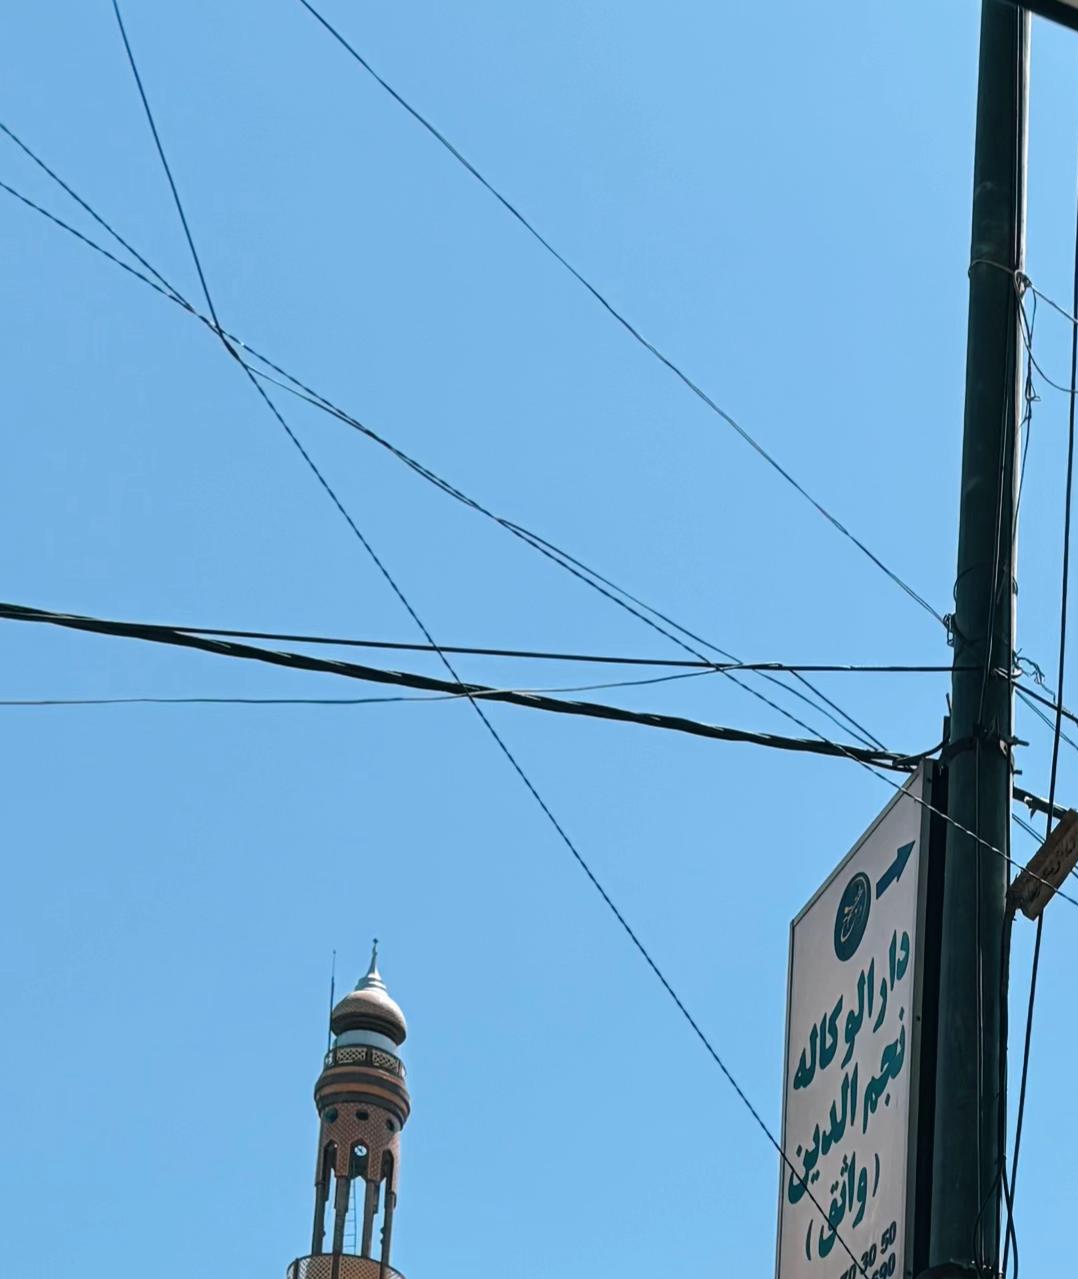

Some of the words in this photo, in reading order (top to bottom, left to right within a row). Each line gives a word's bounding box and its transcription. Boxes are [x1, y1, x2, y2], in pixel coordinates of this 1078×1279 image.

[862, 1006, 906, 1134] نجم
[860, 1243, 877, 1275] 30
[880, 1221, 897, 1254] 50
